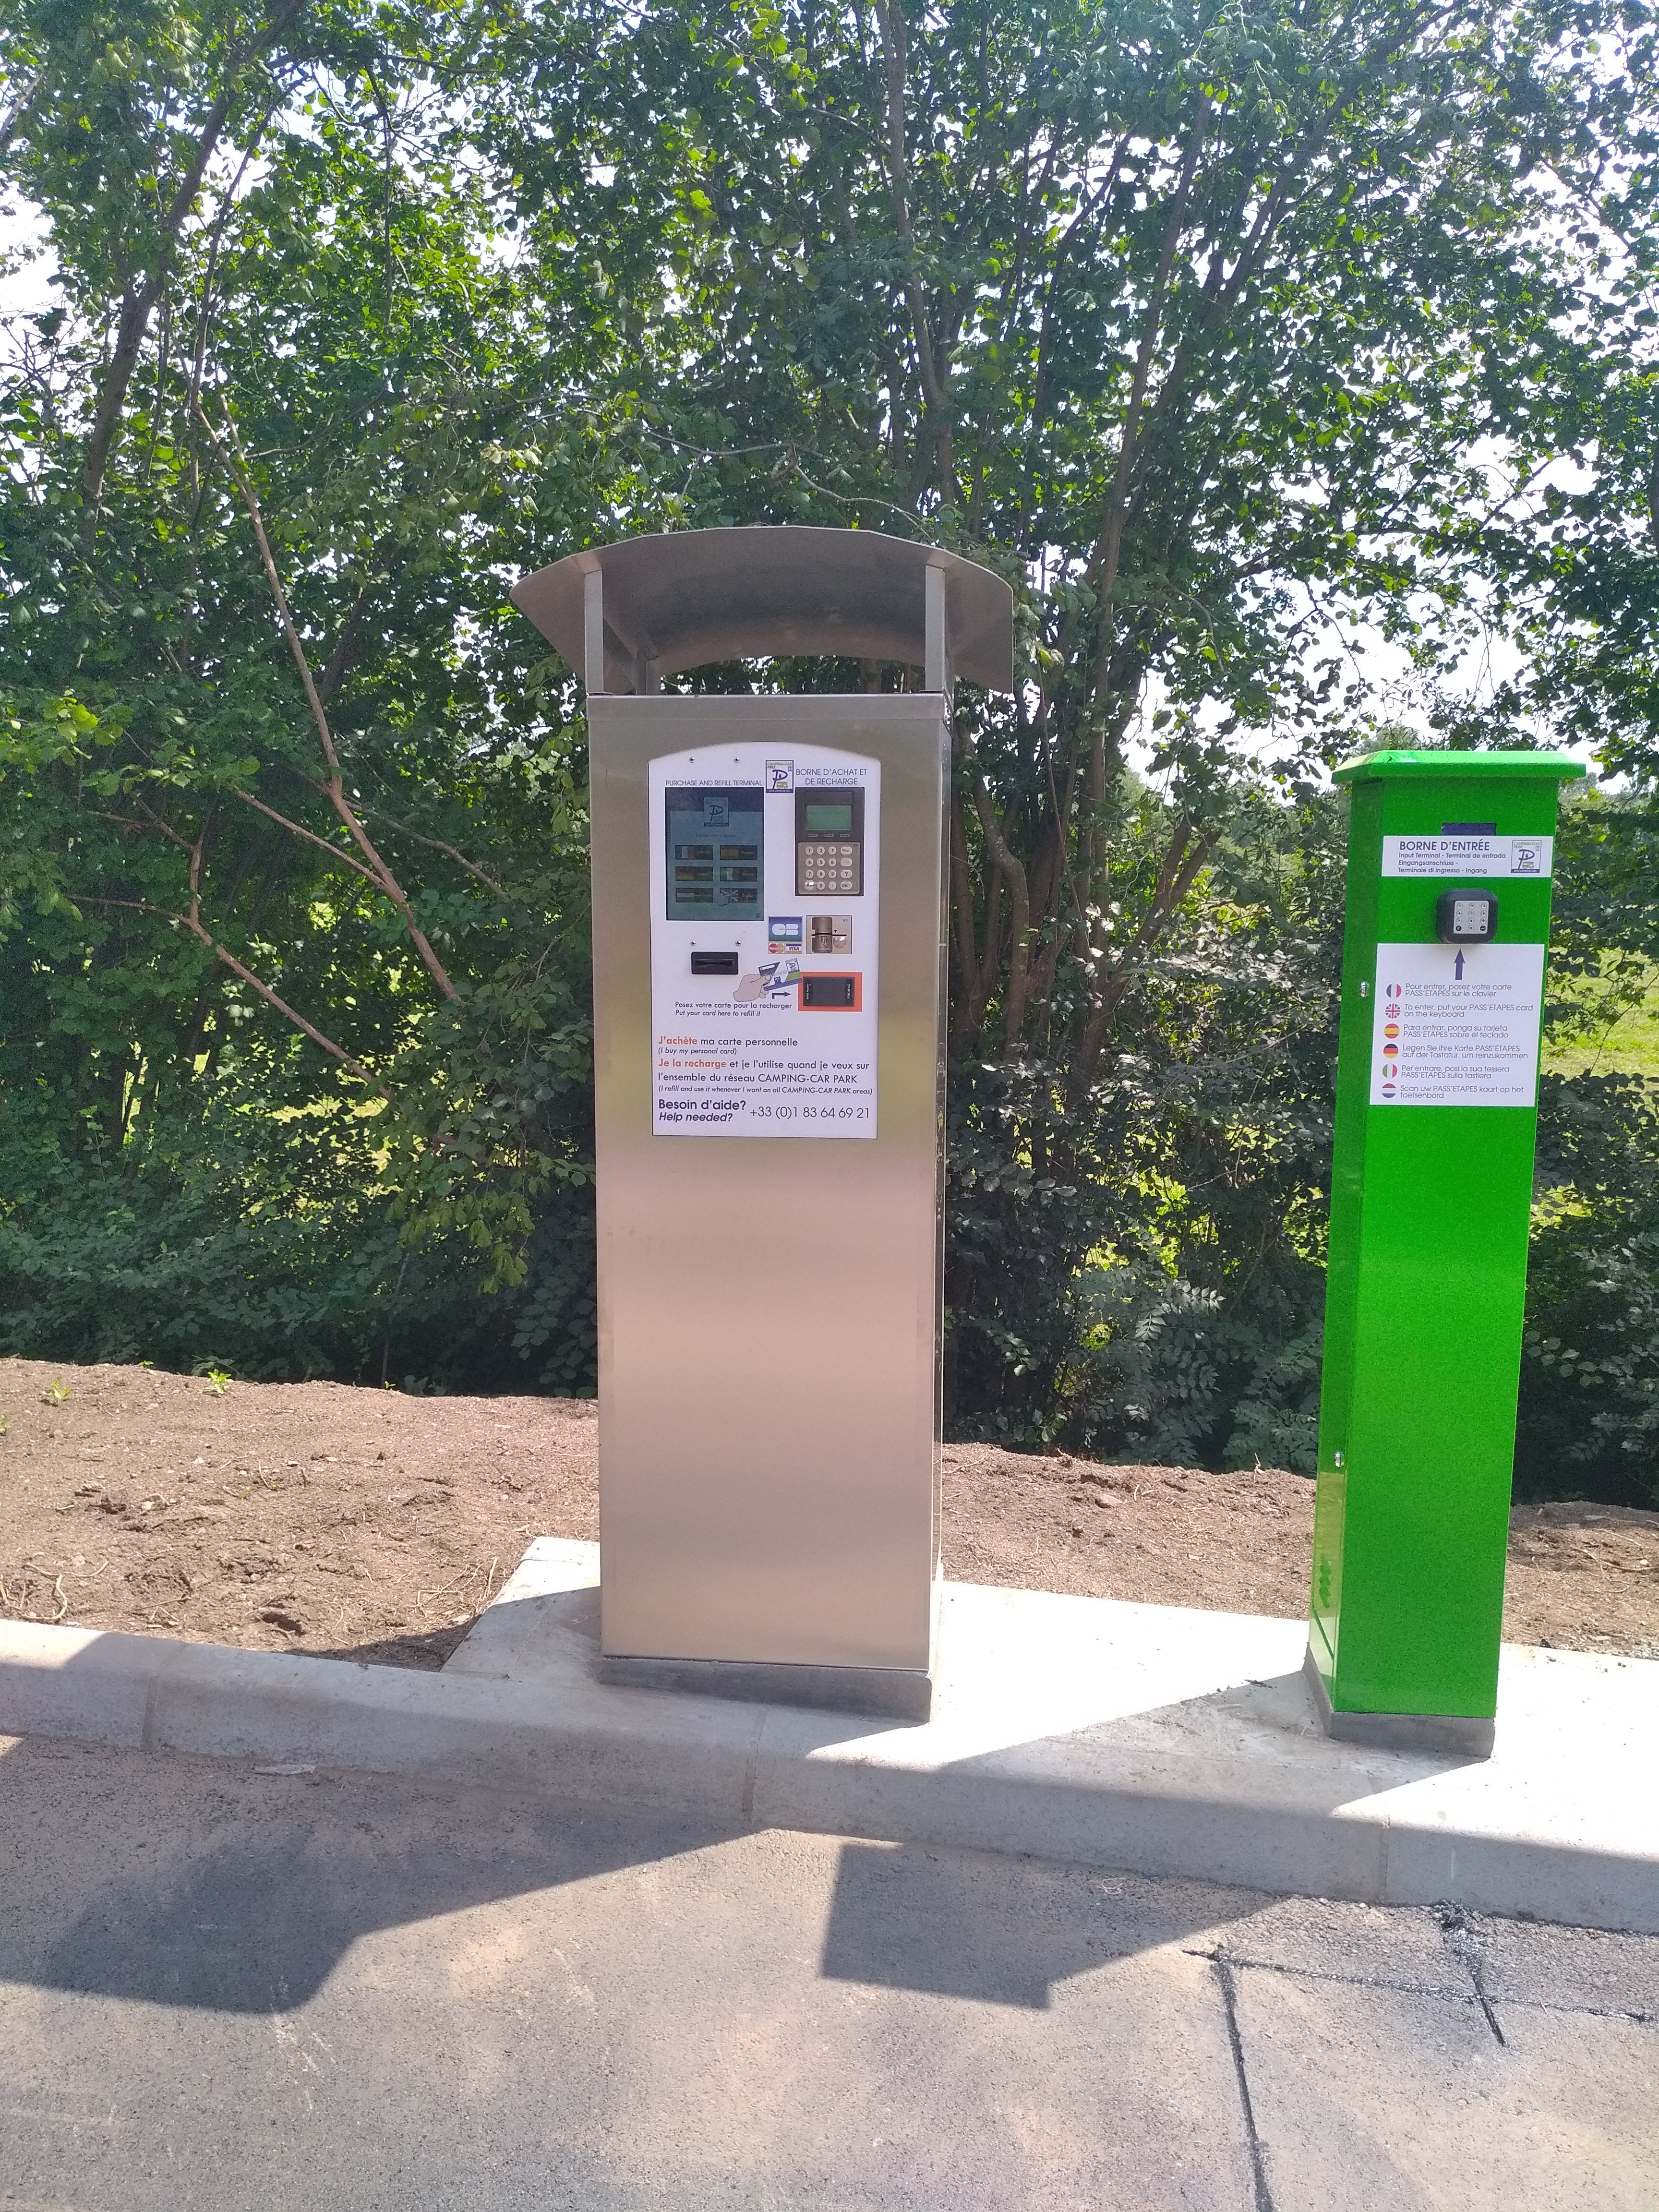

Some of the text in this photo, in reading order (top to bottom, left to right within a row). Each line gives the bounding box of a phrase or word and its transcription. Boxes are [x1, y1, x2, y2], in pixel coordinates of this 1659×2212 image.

[1400, 839, 1490, 851] BORNE D'ENTRÉE
[658, 1036, 697, 1045] J'achète
[745, 1038, 798, 1047] personnelle
[673, 1059, 681, 1067] la
[685, 1059, 726, 1069] recharge
[742, 1060, 750, 1070] je
[754, 1060, 783, 1069] l'utilise
[787, 1061, 817, 1071] quand
[820, 1061, 828, 1071] je
[659, 1073, 706, 1081] l'ensemble
[724, 1073, 755, 1082] réseau
[758, 1074, 830, 1083] CAMPING-CAR
[834, 1075, 857, 1083] PARK
[659, 1099, 746, 1110] Besoin d'aide?
[659, 1112, 733, 1123] Help needed?
[750, 1106, 869, 1119] +33 (0)1 83 64 69 21
